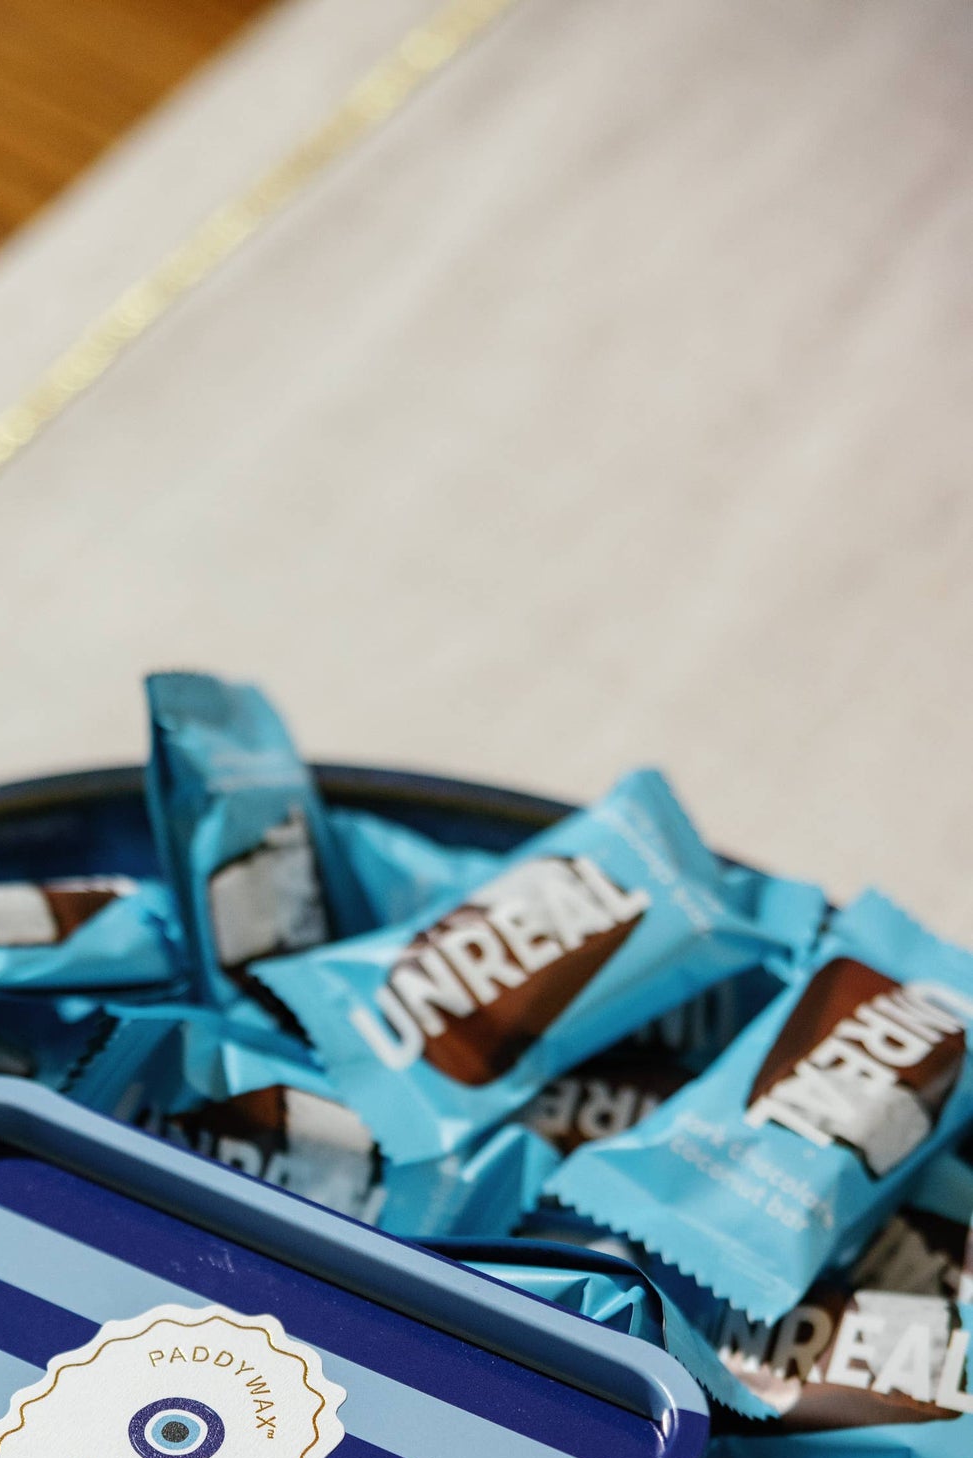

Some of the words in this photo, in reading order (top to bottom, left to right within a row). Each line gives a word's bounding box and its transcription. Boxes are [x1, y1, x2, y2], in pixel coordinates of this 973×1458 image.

[349, 856, 651, 1070] UNREAL
[743, 978, 973, 1148] UNREAL
[718, 1300, 973, 1414] NREAL
